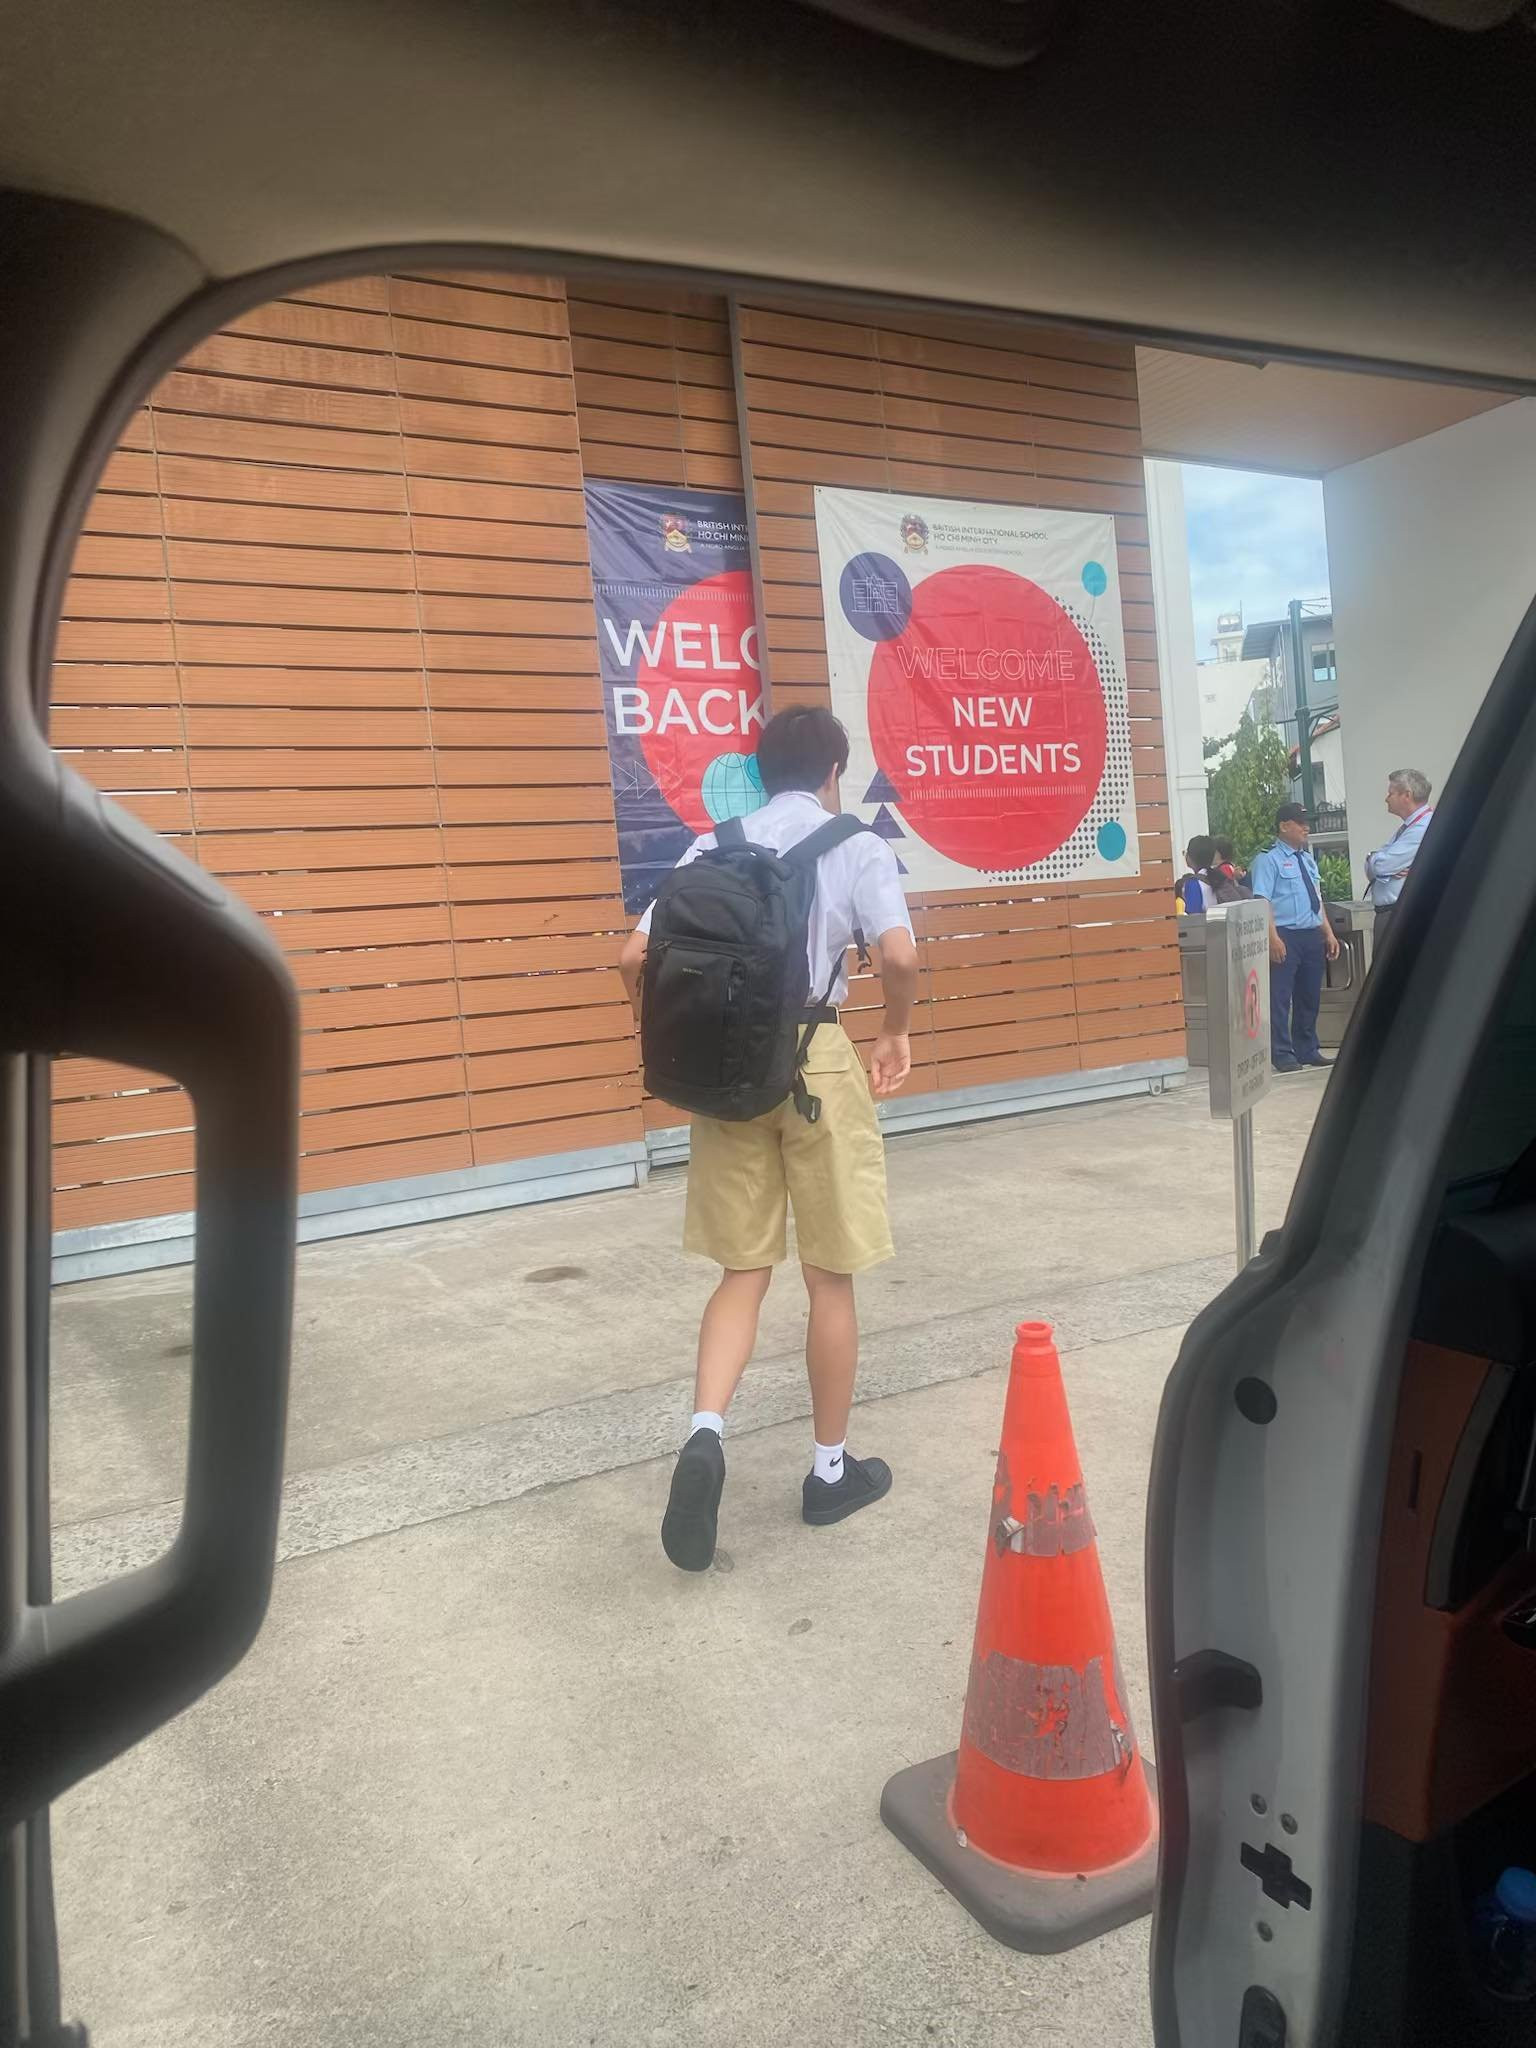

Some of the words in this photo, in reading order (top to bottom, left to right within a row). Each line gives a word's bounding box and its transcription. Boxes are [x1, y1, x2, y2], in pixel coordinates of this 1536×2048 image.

[697, 521, 730, 530] BRITISH
[698, 531, 712, 540] HO
[713, 532, 729, 541] CHI
[1020, 531, 1048, 541] SCHOOL
[946, 535, 960, 543] CHI
[897, 645, 1076, 681] WELCOME
[612, 687, 767, 736] BACK
[951, 696, 1033, 728] NEW
[905, 742, 1082, 778] STUDENTS
